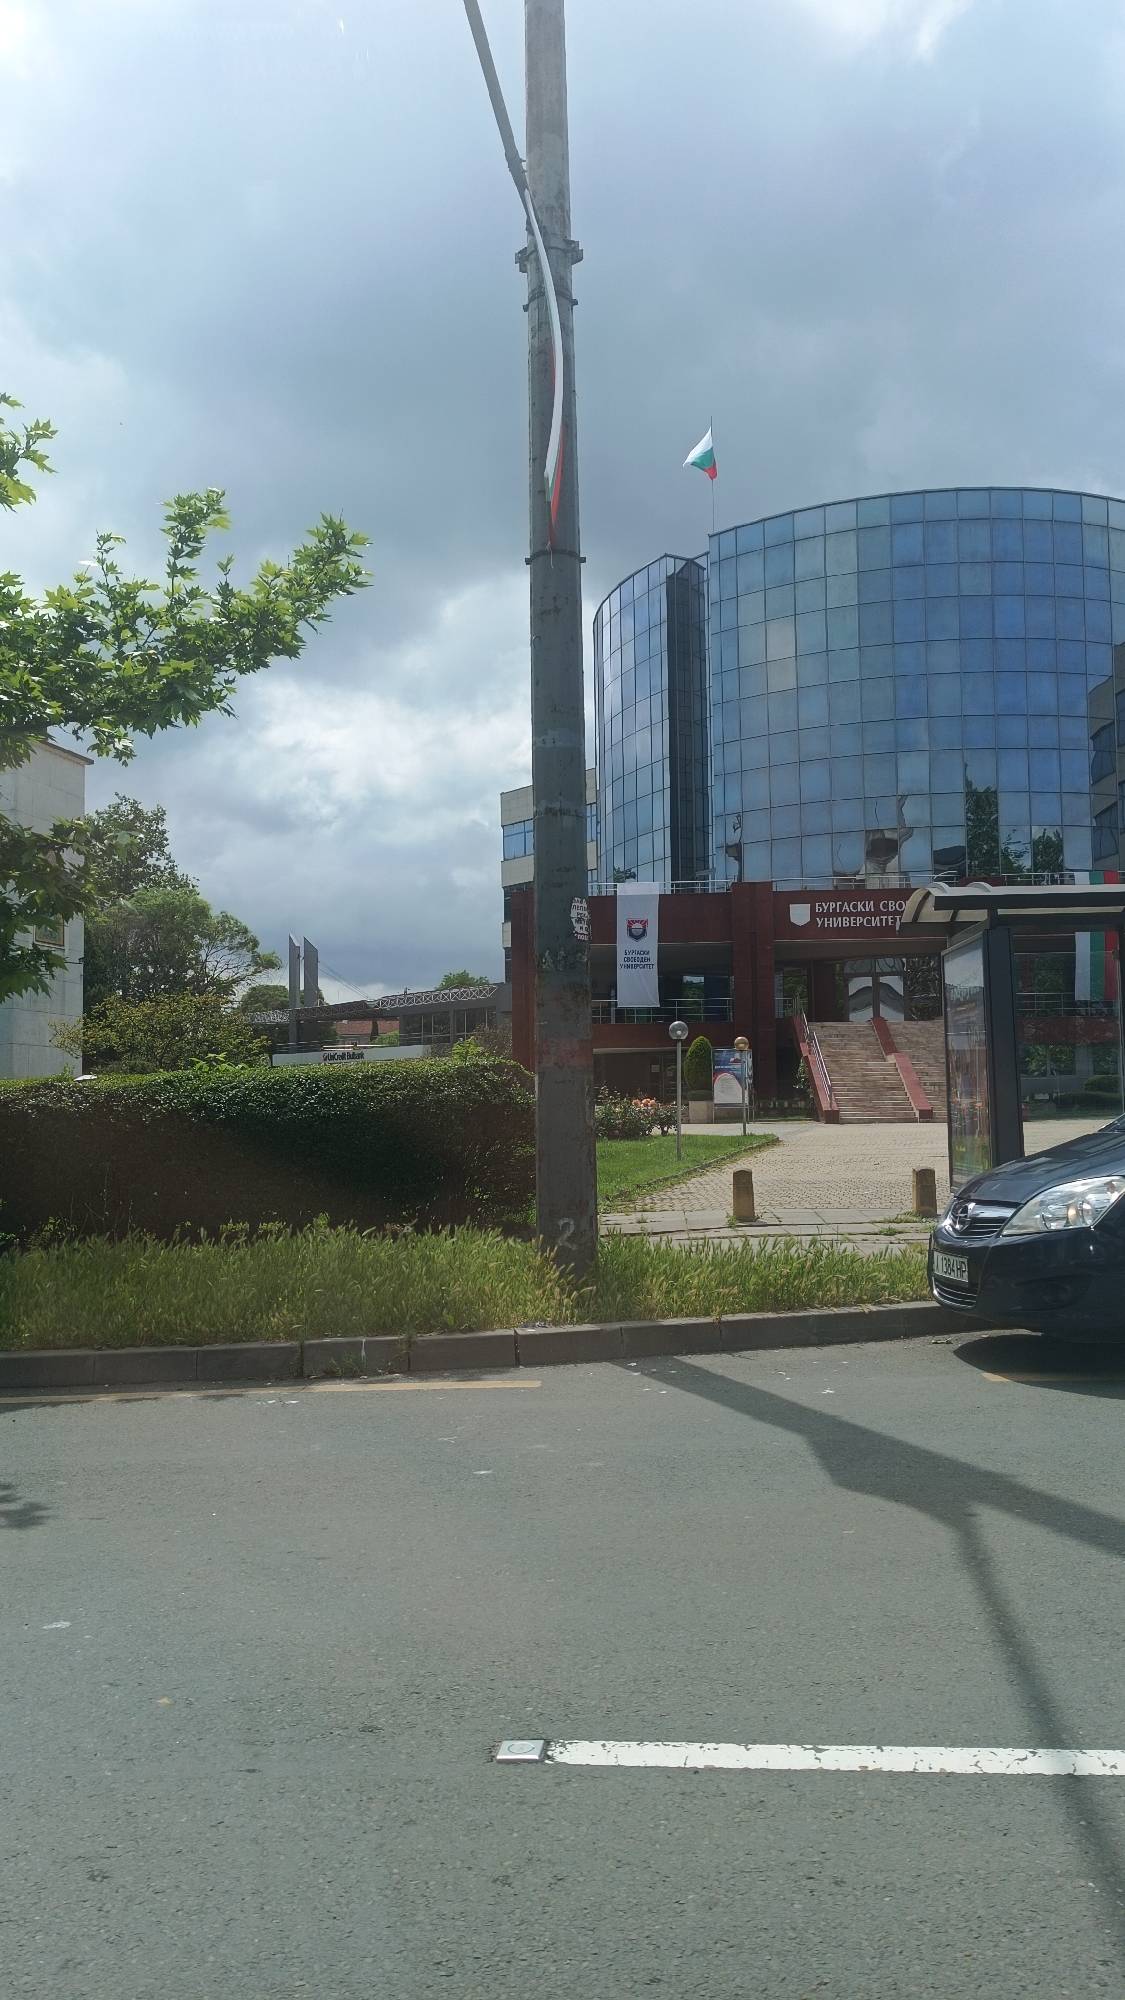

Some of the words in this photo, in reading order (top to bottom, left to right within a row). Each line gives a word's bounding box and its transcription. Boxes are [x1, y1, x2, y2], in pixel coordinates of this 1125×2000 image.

[815, 901, 875, 913] БУРГАСКИ
[880, 900, 907, 912] СВО
[816, 915, 901, 928] УНИВЕРСИТЕТ
